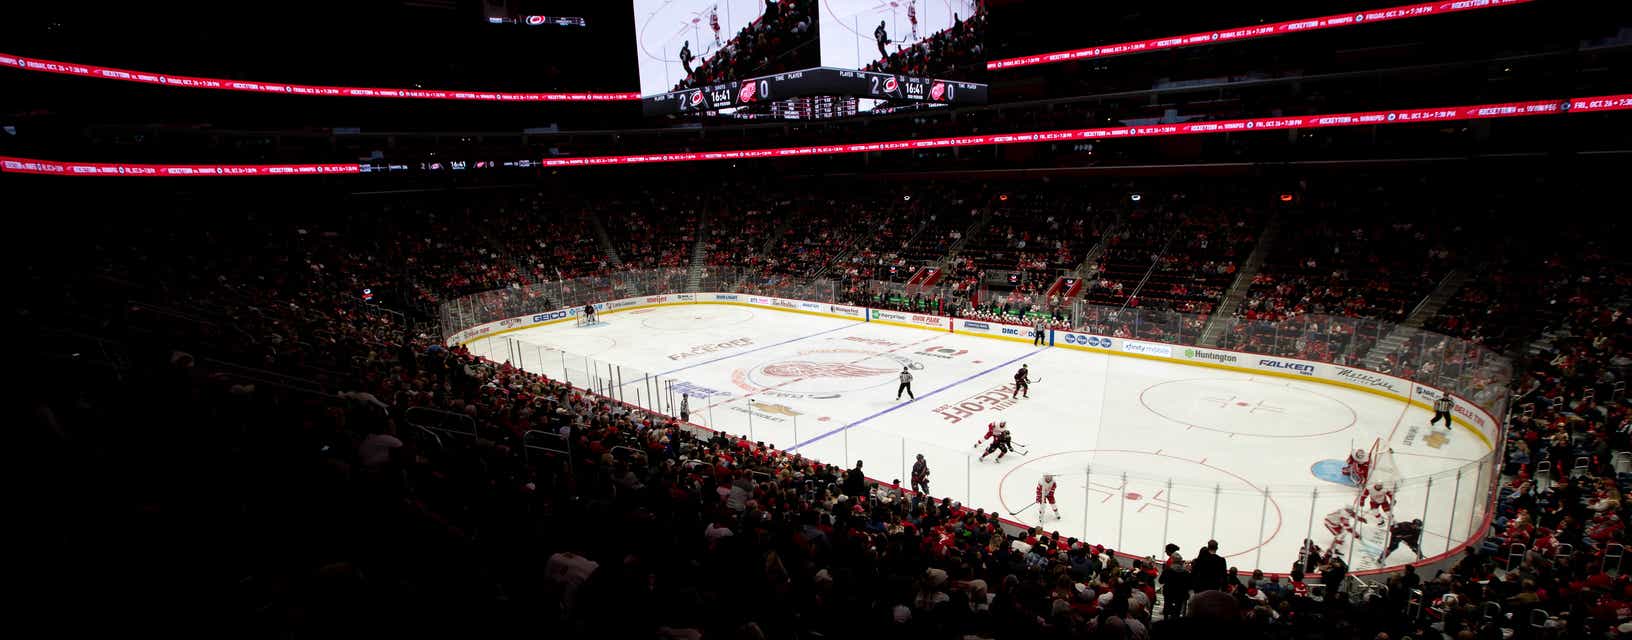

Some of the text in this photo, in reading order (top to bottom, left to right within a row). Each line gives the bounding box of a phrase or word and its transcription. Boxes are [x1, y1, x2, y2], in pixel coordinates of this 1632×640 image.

[760, 80, 768, 98] 0
[871, 76, 879, 94] 2
[906, 83, 923, 94] 16:41
[948, 84, 954, 99] 0
[680, 94, 687, 110] 2
[711, 90, 730, 102] 16:41
[533, 311, 566, 323] GEICO
[1195, 350, 1237, 362] Huntington
[1259, 360, 1314, 372] FALKEN
[1454, 404, 1473, 418] BELLE
